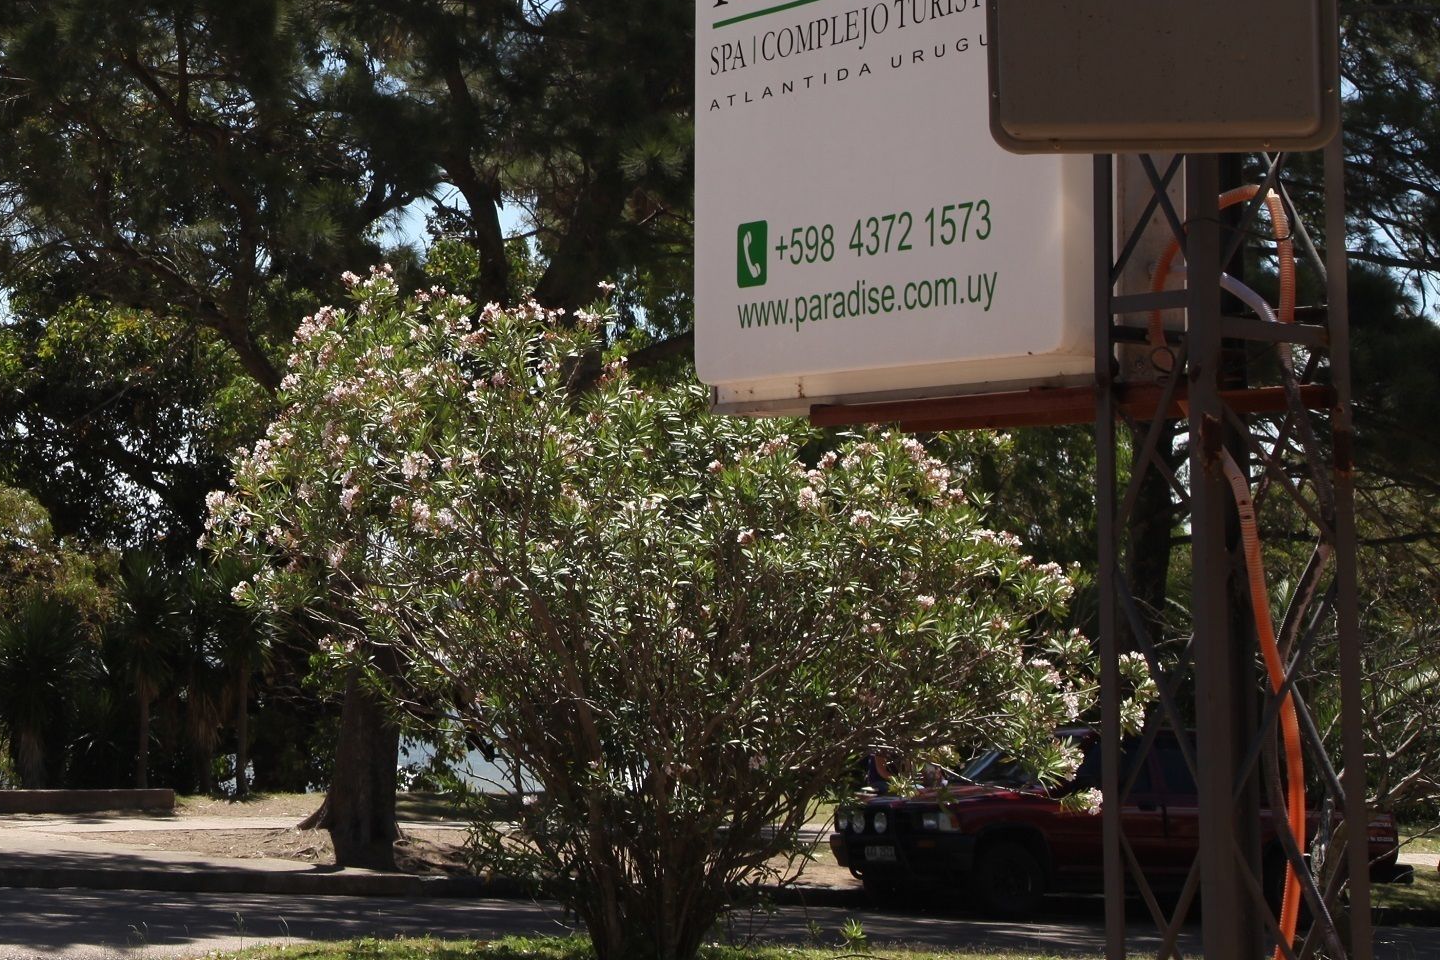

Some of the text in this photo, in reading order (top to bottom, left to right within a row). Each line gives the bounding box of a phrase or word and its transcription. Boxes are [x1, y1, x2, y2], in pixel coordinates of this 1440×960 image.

[710, 40, 747, 76] SPA
[762, 2, 889, 61] COMPLEJO
[709, 62, 872, 112] ATLANTIDA
[774, 199, 992, 265] +598 4372 1573
[737, 271, 998, 332] www.paradise.com.uy
